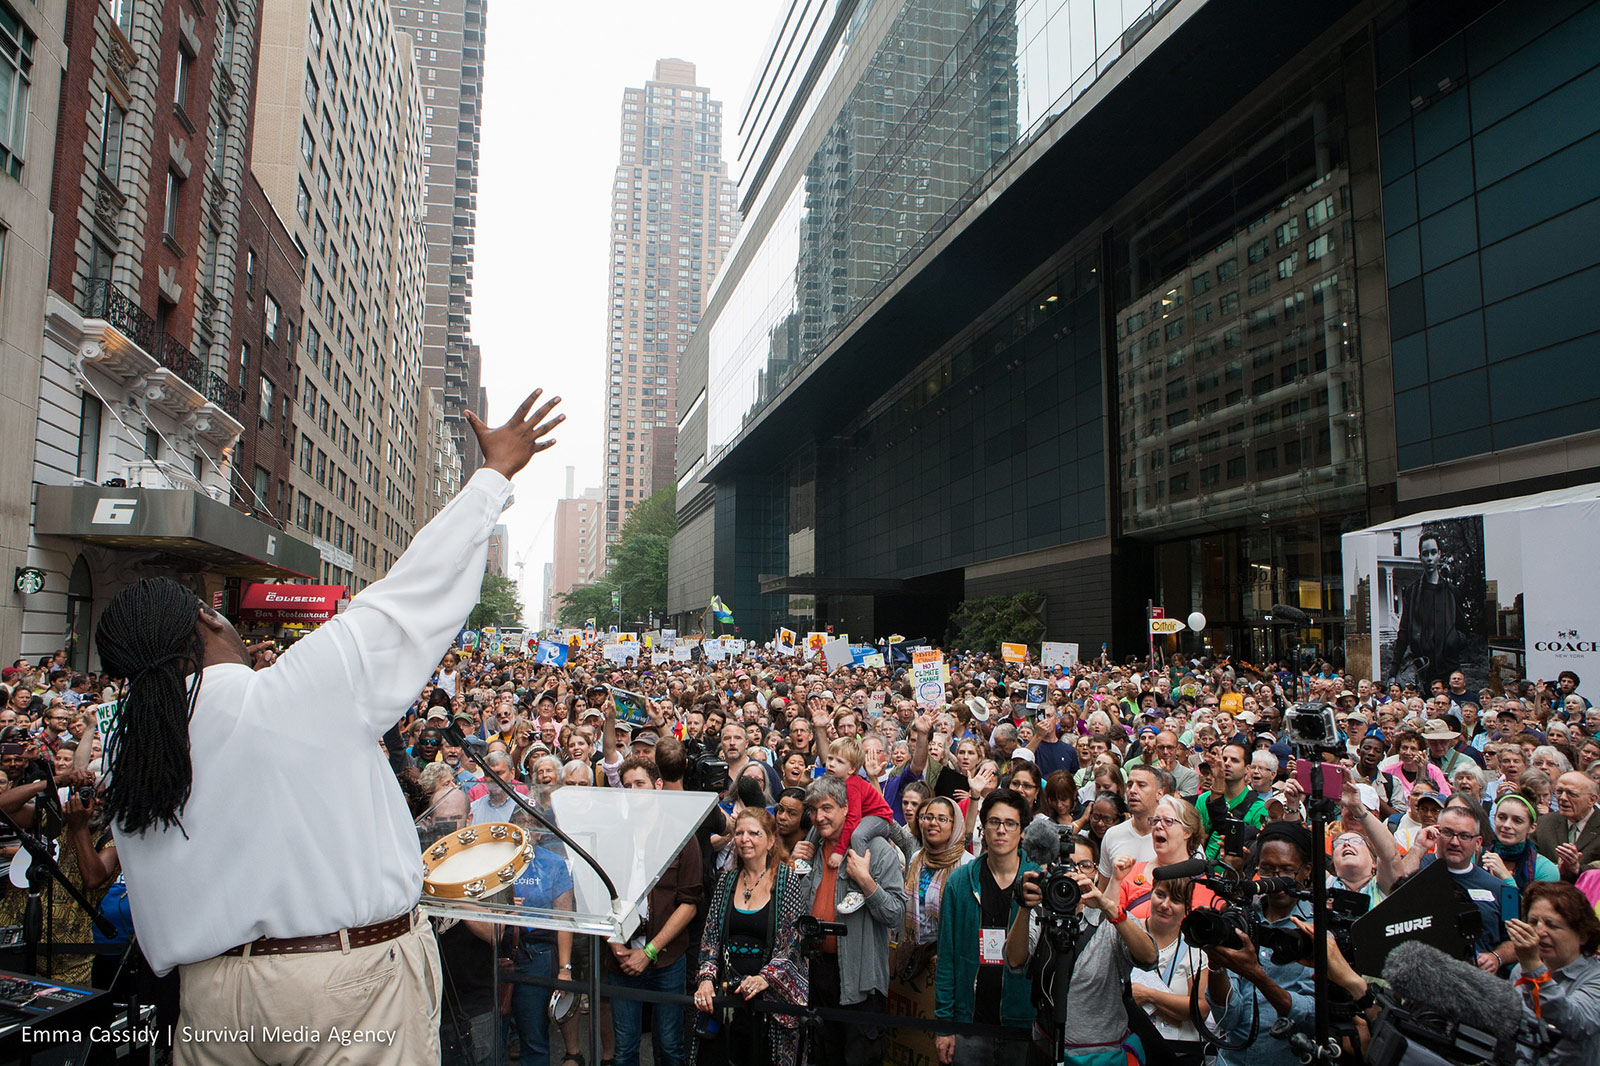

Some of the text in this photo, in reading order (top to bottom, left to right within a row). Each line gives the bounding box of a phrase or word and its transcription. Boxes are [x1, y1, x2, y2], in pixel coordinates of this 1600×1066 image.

[265, 593, 326, 603] COLISEUM
[254, 609, 330, 619] Bar Restaurant
[915, 650, 938, 658] SYSTEM
[914, 669, 939, 677] CLIMATE
[97, 705, 111, 720] WE
[1385, 916, 1432, 937] SHURE
